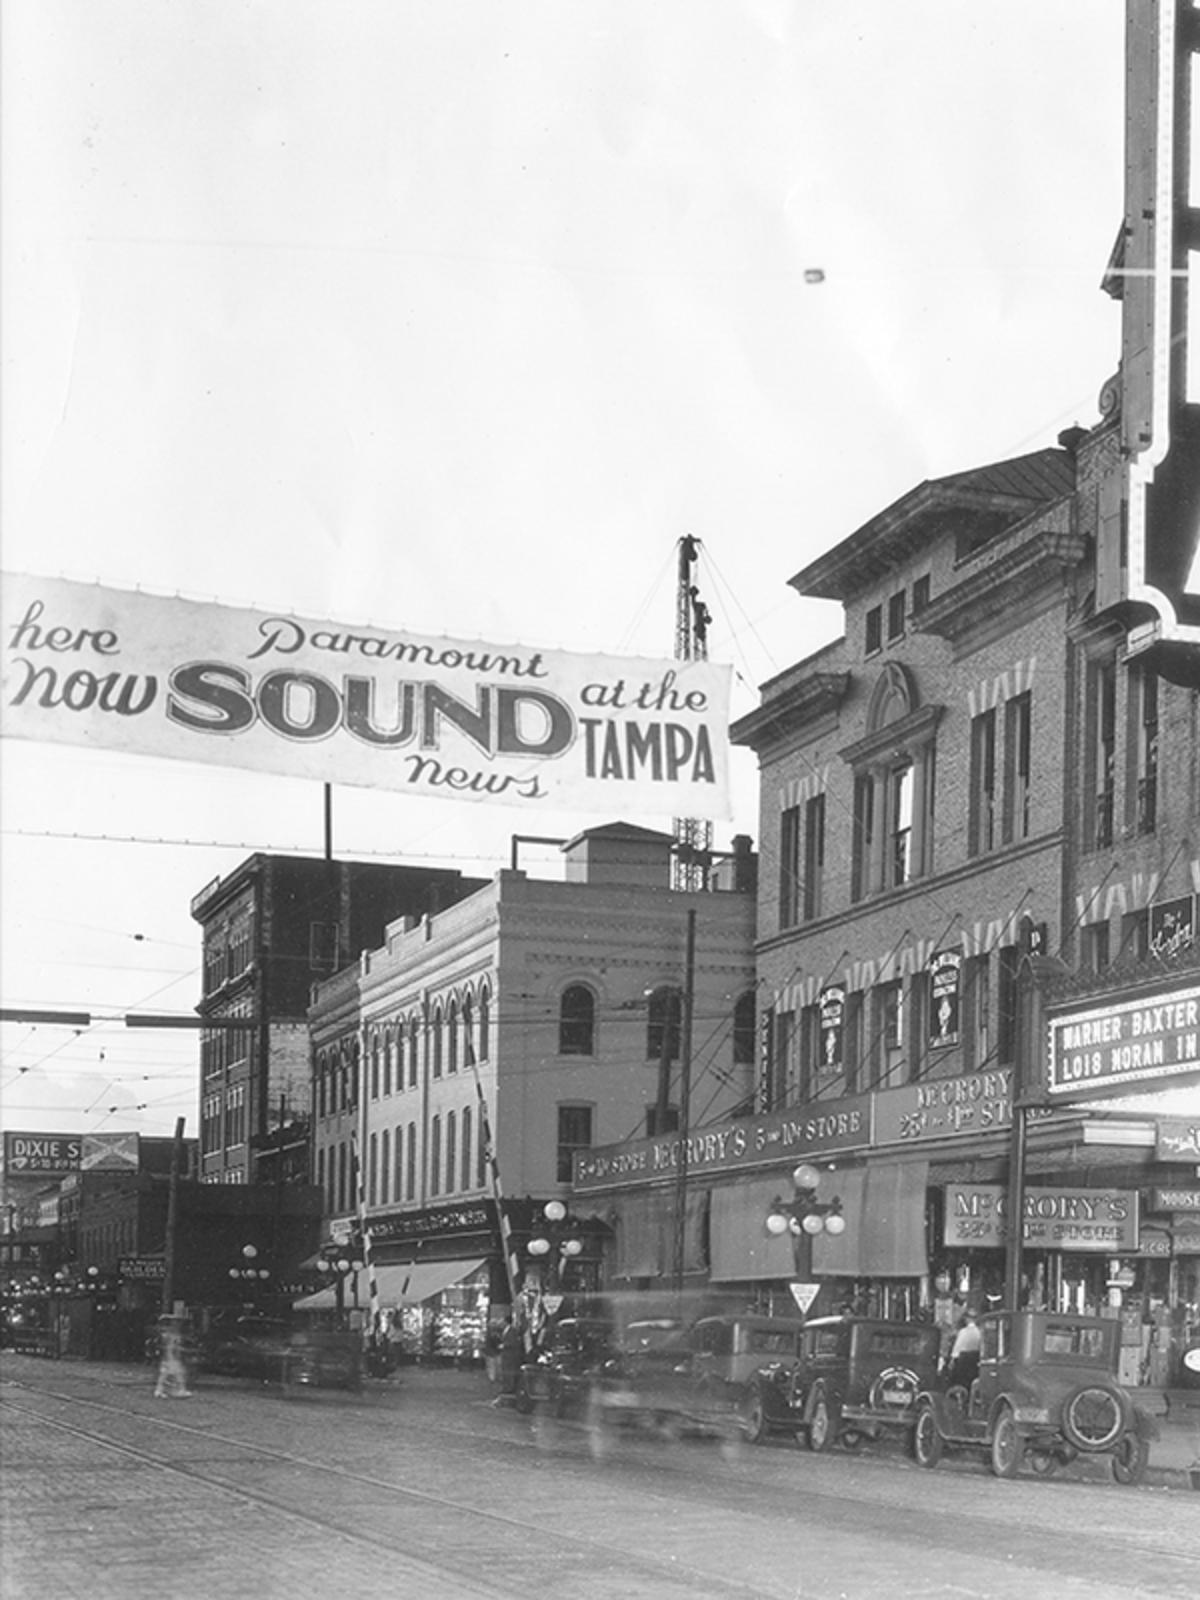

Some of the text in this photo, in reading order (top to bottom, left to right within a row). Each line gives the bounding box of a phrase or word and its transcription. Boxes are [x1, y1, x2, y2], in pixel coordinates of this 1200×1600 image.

[9, 600, 121, 656] here
[247, 617, 549, 679] Paramount
[9, 656, 577, 761] now SOUND
[580, 670, 708, 713] at the
[580, 718, 716, 783] TAMPA
[405, 753, 548, 798] news
[1063, 1017, 1121, 1050] WARNER
[1132, 1001, 1198, 1036] BAXTER
[1063, 1033, 1197, 1080] LOIS MORAN IN
[15, 1139, 60, 1158] DIXIE
[805, 1111, 861, 1141] STORE
